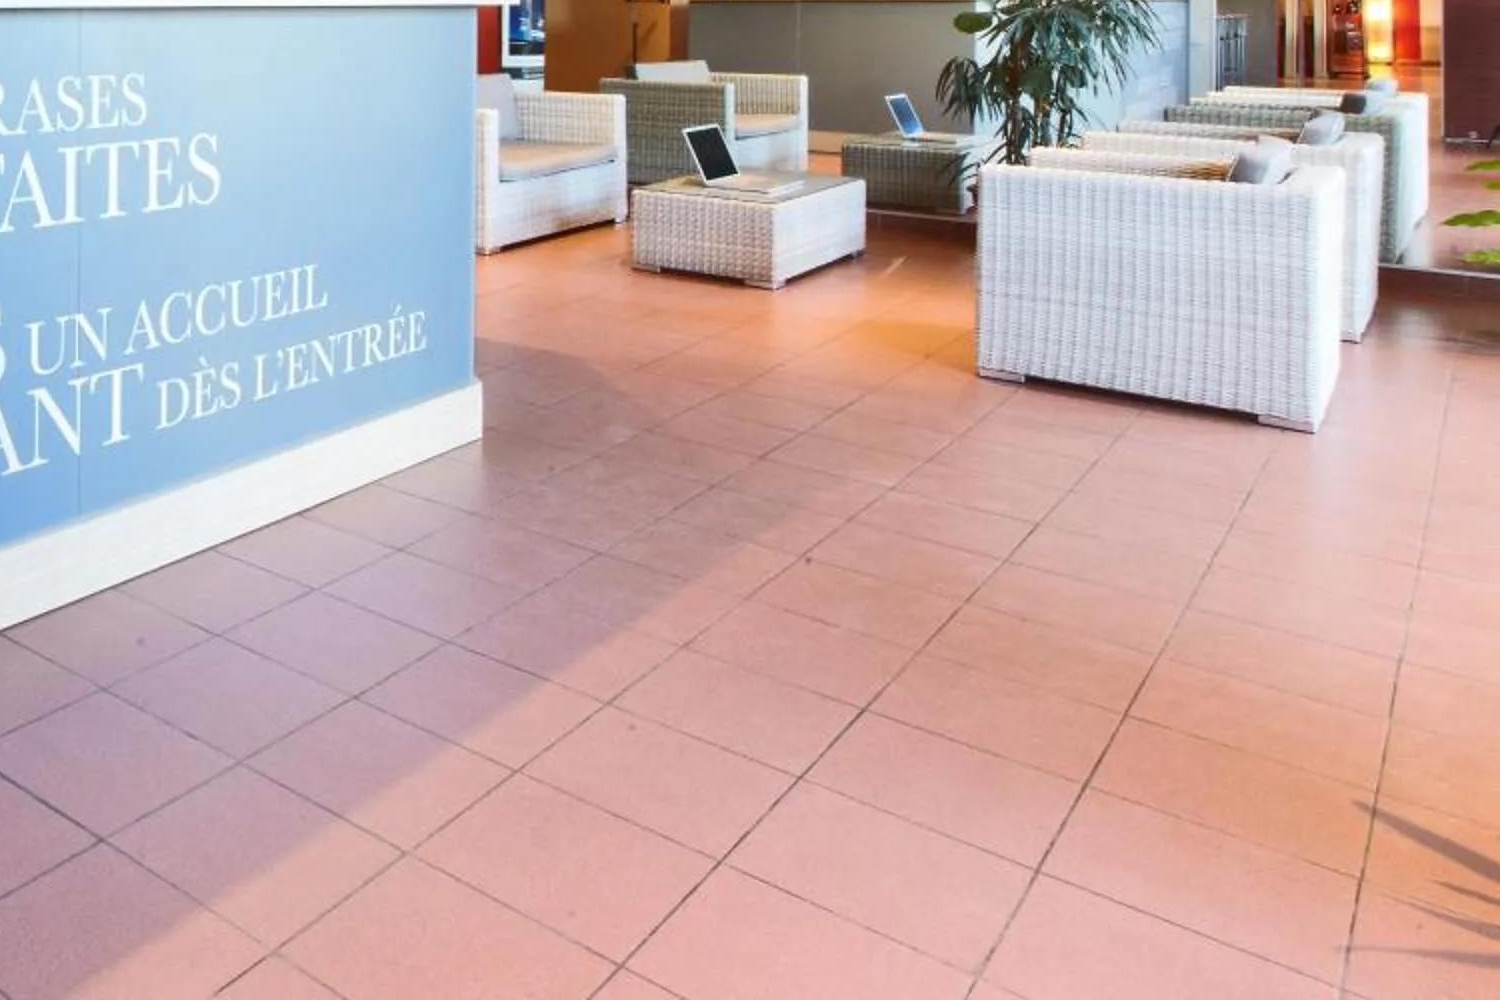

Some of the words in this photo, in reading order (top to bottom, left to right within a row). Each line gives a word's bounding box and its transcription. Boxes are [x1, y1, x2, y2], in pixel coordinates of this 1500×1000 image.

[24, 307, 114, 377] UN
[124, 263, 329, 356] ACCUEIL
[154, 356, 242, 431] DÈS
